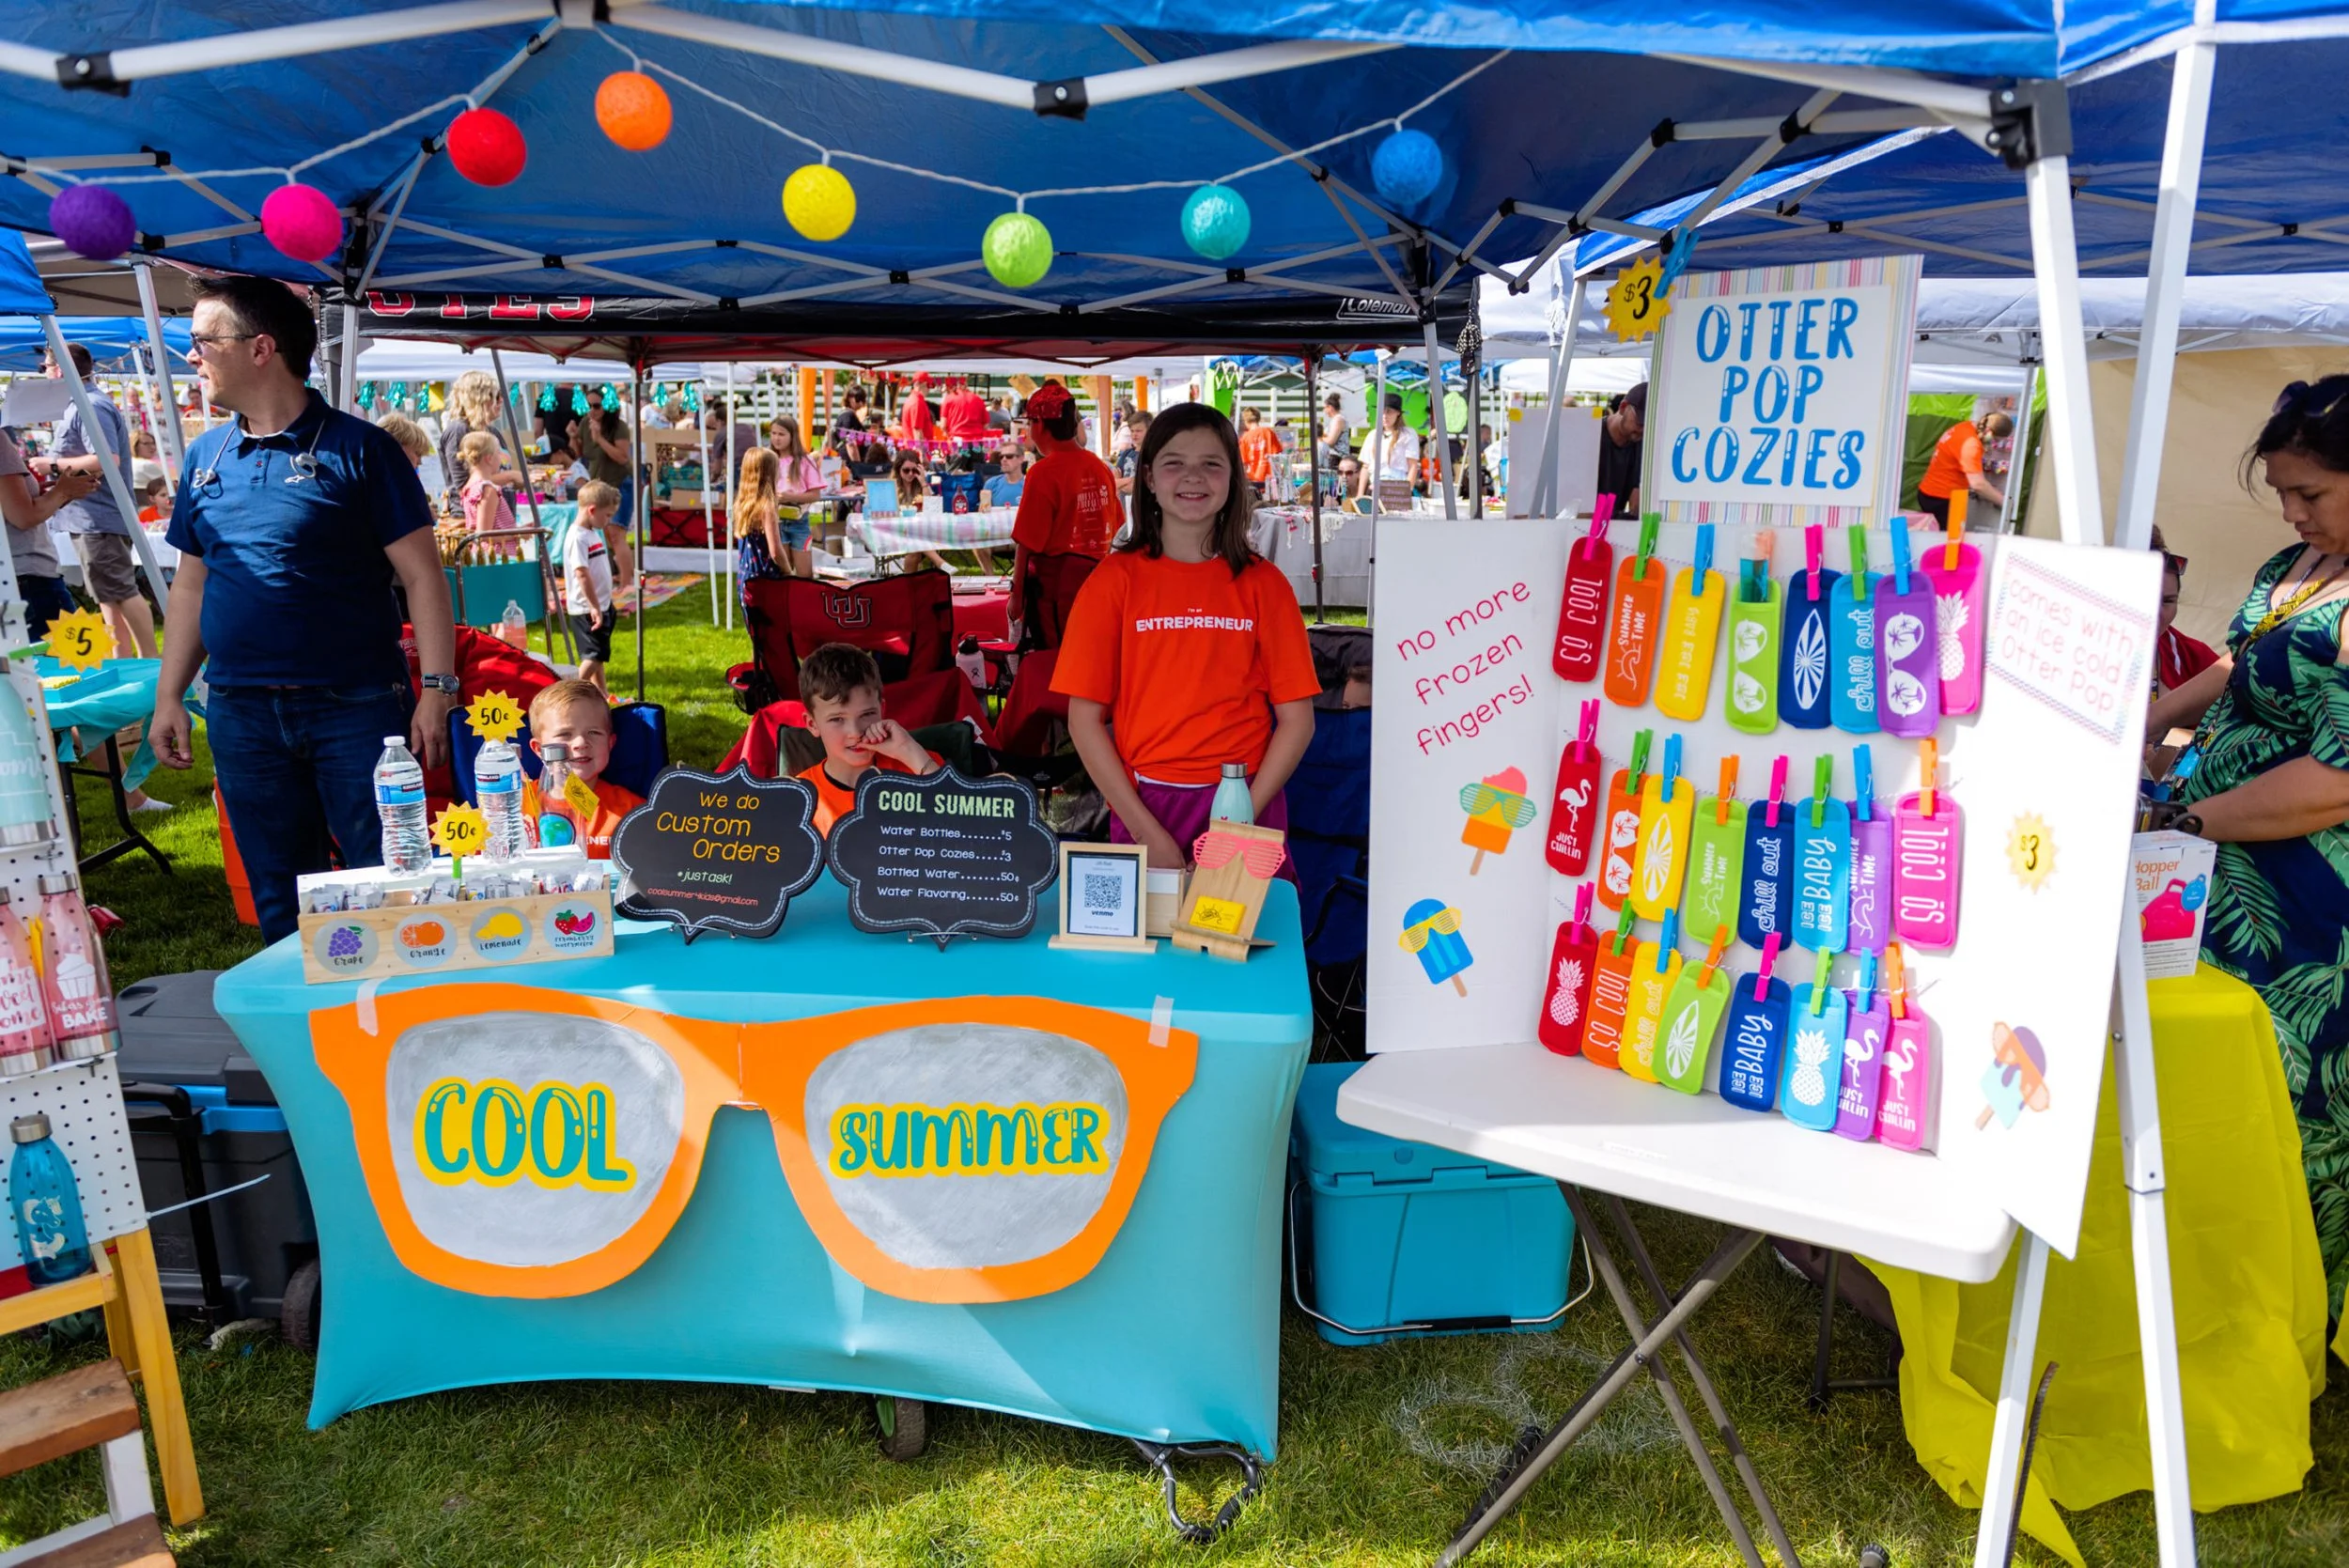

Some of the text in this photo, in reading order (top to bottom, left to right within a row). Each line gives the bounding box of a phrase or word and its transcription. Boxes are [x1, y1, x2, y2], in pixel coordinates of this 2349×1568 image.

[1624, 275, 1652, 319] $3
[1696, 297, 1859, 363] OTTER
[1719, 365, 1824, 424] POP
[1671, 426, 1865, 489] COZIES
[64, 627, 93, 656] $5
[1135, 615, 1253, 632] ENTREPRENEUR
[1397, 582, 1531, 661] no more
[1560, 577, 1603, 664] SO COOL
[2080, 614, 2135, 657] with
[1415, 634, 1523, 705] frozen
[1846, 607, 1875, 712] chill out
[2001, 634, 2063, 683] Otter
[2006, 609, 2123, 684] an ice cold
[1417, 674, 1534, 755] fingers!
[699, 791, 760, 810] We do
[878, 790, 1015, 818] COOL SUMMER
[656, 812, 752, 837] Custom
[879, 826, 916, 836] Water
[692, 838, 781, 863] Orders
[877, 866, 920, 877] Bottled
[879, 846, 911, 856] Otter
[1802, 836, 1837, 901] BABY
[877, 887, 913, 897] Water
[1751, 836, 1781, 933] chill out
[1900, 827, 1950, 924] SO COOL
[1800, 900, 1815, 929] ICE
[1817, 903, 1833, 932] ICE
[61, 1006, 108, 1030] BAKE
[1589, 968, 1631, 1052] SO COOL
[1735, 1014, 1773, 1074] BABY
[1731, 1070, 1747, 1094] ICE
[1749, 1075, 1764, 1098] ICE
[420, 1081, 631, 1184] COOL
[837, 1105, 1102, 1172] SUMMER
